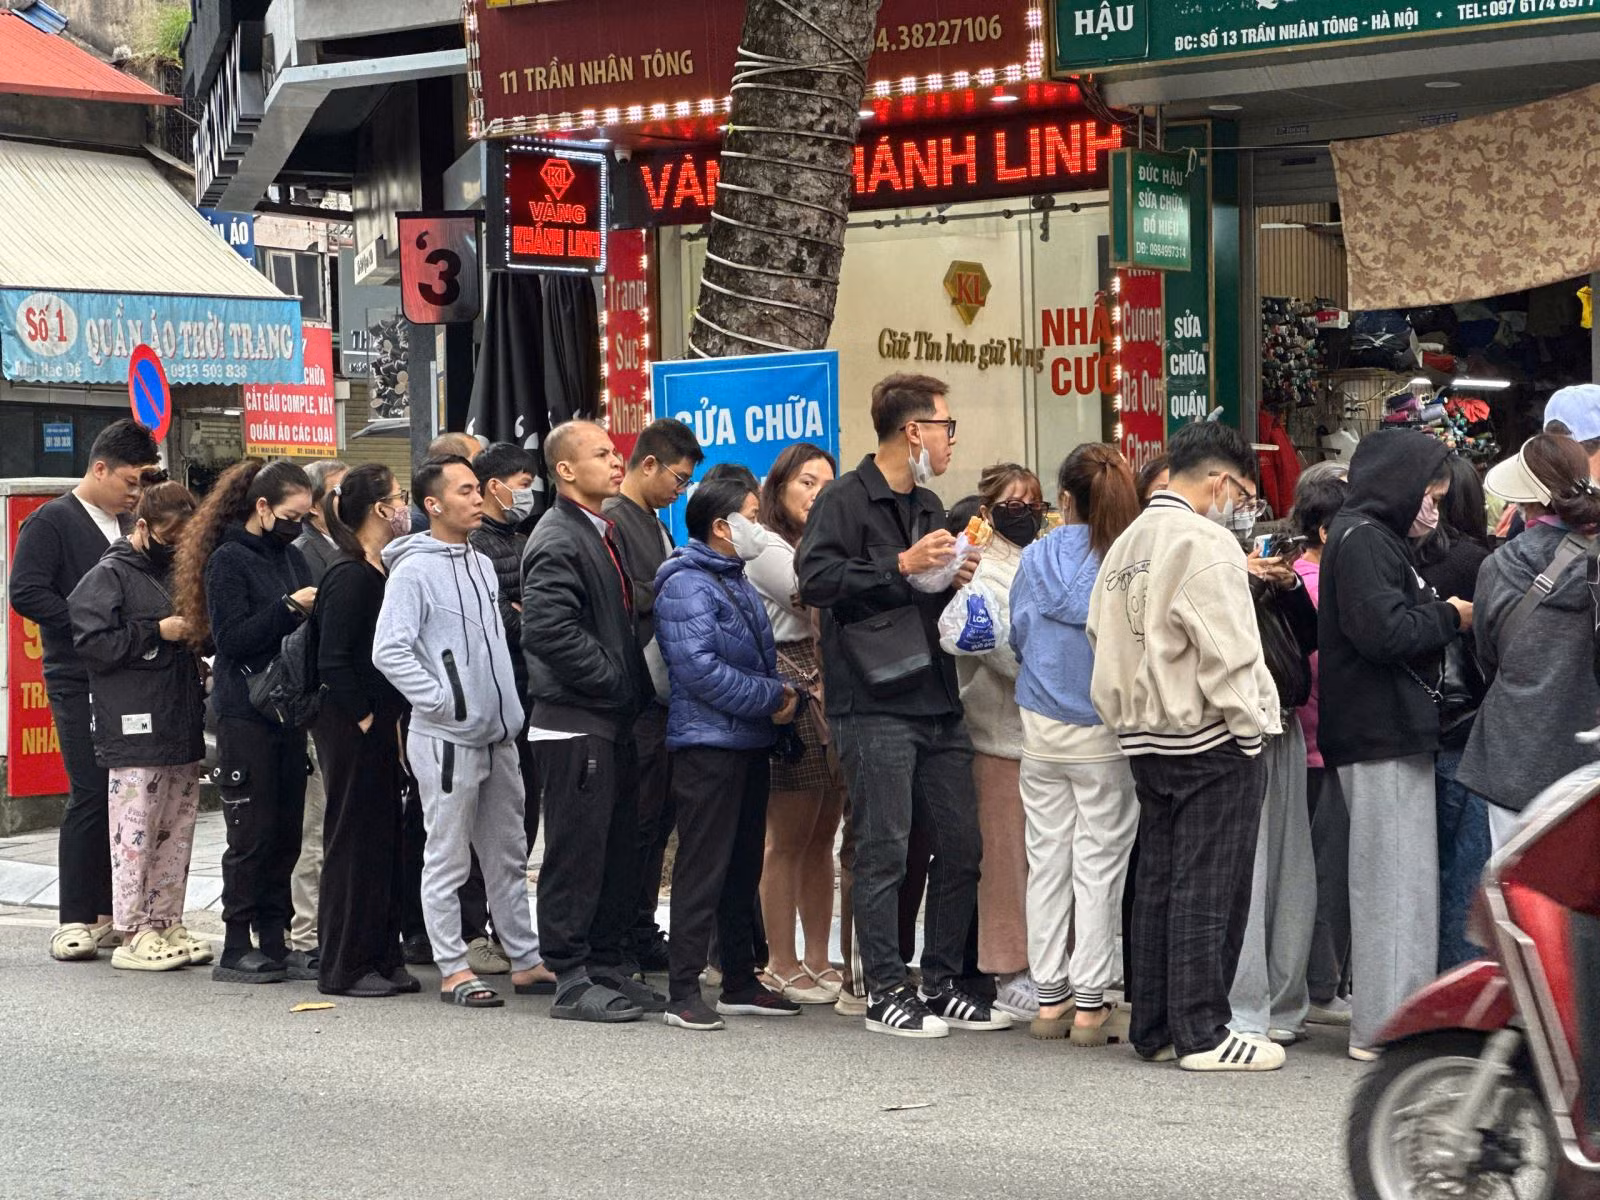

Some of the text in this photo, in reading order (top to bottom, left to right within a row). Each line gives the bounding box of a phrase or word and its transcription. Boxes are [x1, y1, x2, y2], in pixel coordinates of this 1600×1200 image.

[1074, 1, 1134, 41] HẬU
[1175, 36, 1197, 51] ĐC:
[1200, 27, 1218, 48] SỐ
[1221, 30, 1238, 46] 13
[1241, 22, 1276, 43] TRẦN
[1279, 19, 1318, 40] NHÂN
[1322, 15, 1358, 35] TÔNG
[1371, 10, 1390, 30] HÀ
[1394, 7, 1419, 30] NỘI
[1458, 4, 1487, 20] TEL:
[1490, 1, 1515, 16] 097
[500, 48, 694, 94] 11 TRẦN NHÂN TÔNG
[996, 121, 1122, 181] LINH
[1138, 162, 1183, 189] ĐỨC HẬU
[529, 194, 587, 224] VÀNG
[1138, 187, 1184, 213] SỬA CHỮA
[230, 217, 249, 245] ÁO
[513, 222, 564, 256] KHÁNH
[956, 272, 985, 307] KL
[26, 304, 68, 342] Số 1
[85, 298, 294, 366] QUẦN ÁO THỜI TRANG
[1174, 309, 1202, 338] SỬA
[879, 328, 911, 360] Giữ
[914, 330, 943, 362] Tín
[945, 332, 977, 364] hơn
[978, 338, 1007, 371] giữ
[1170, 350, 1206, 376] CHỮA
[171, 364, 199, 378] 0913
[202, 364, 223, 378] 503
[225, 364, 248, 378] 838
[303, 364, 326, 386] CHỮA
[245, 386, 333, 416] CẮT GẤU COMPLE, VÁY
[1171, 389, 1207, 419] QUẦN
[745, 394, 824, 443] CHỮA
[278, 422, 291, 442] ÁO
[292, 422, 311, 442] CÁC
[312, 426, 333, 446] LOẠI
